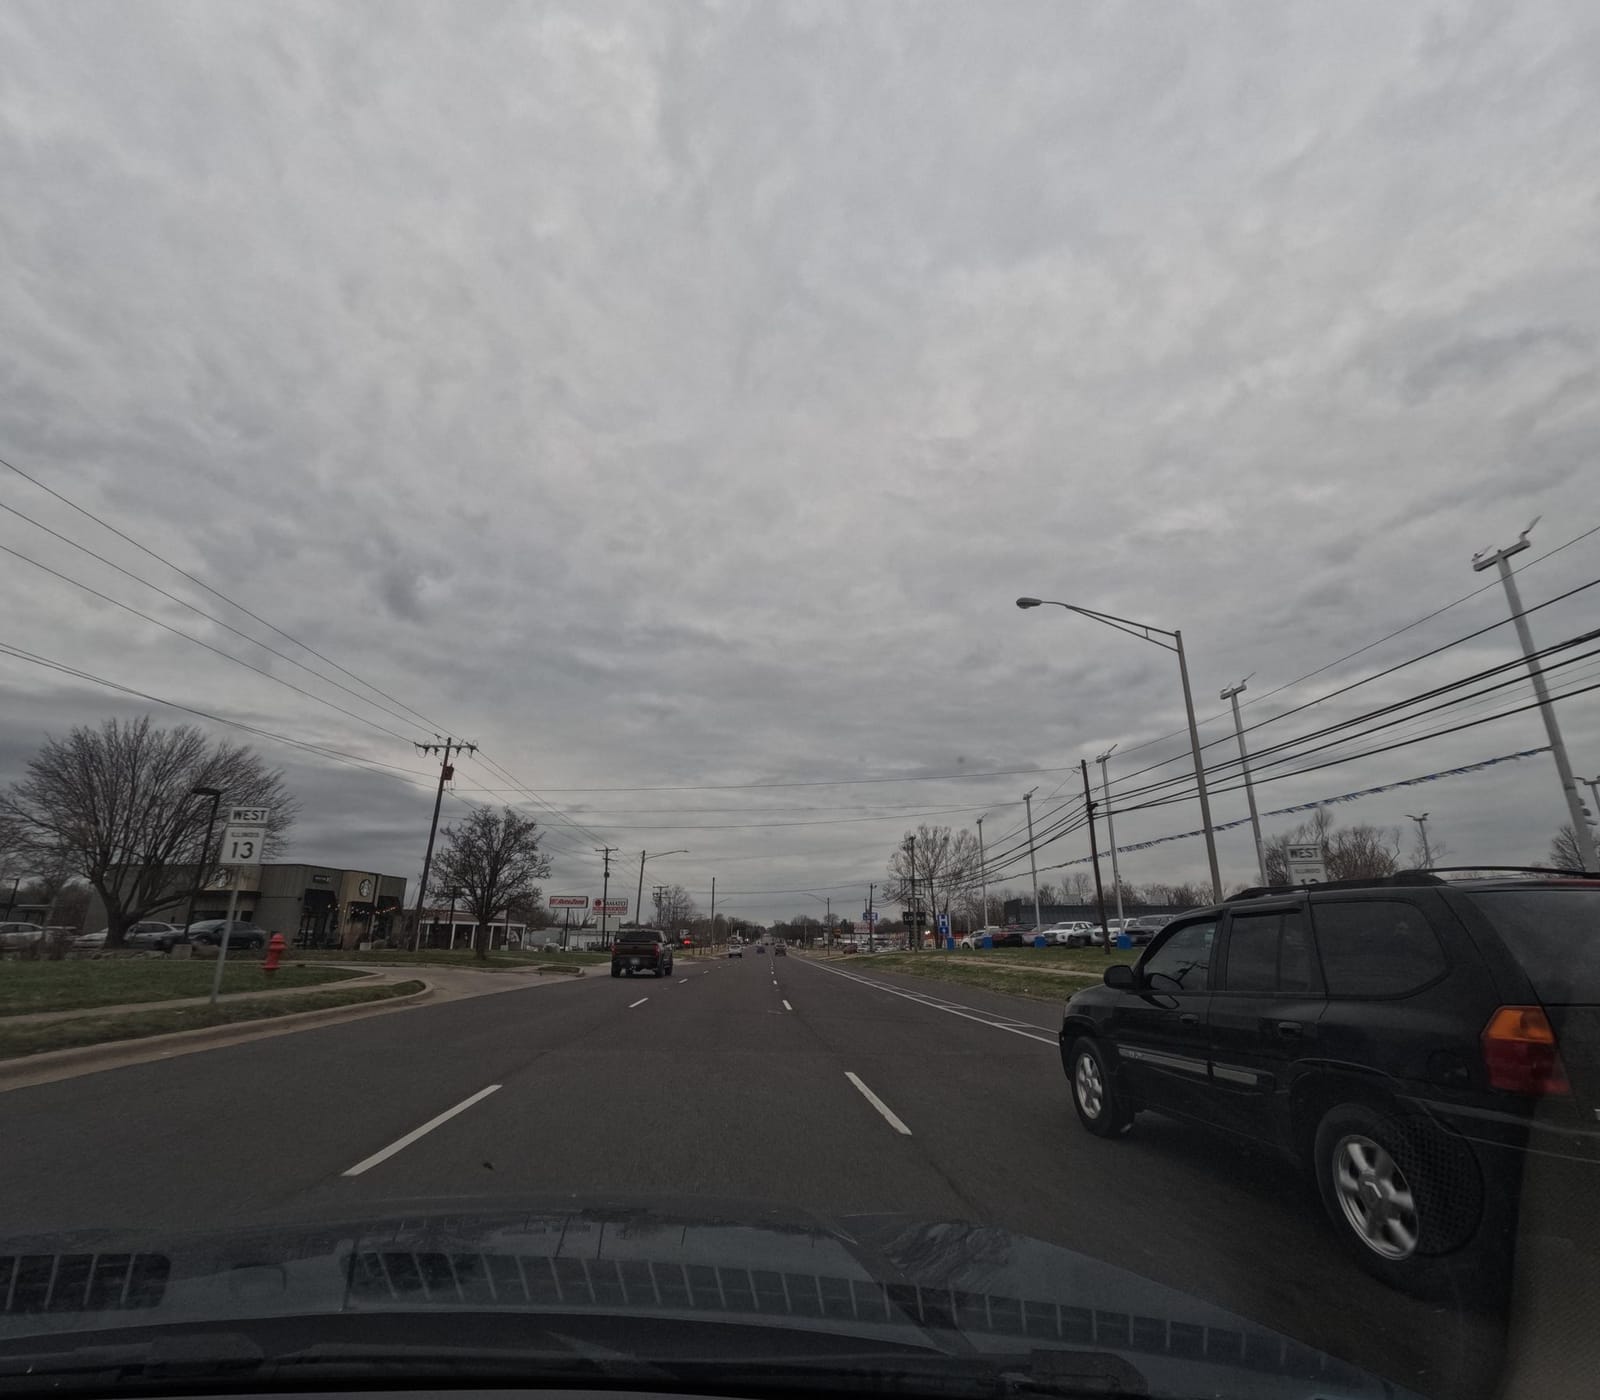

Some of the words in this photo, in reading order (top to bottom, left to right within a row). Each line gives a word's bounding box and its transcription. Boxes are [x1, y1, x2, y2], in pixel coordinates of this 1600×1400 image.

[233, 809, 268, 821] WEST
[231, 841, 254, 859] 13
[1289, 847, 1319, 859] WEST
[938, 914, 948, 927] H
